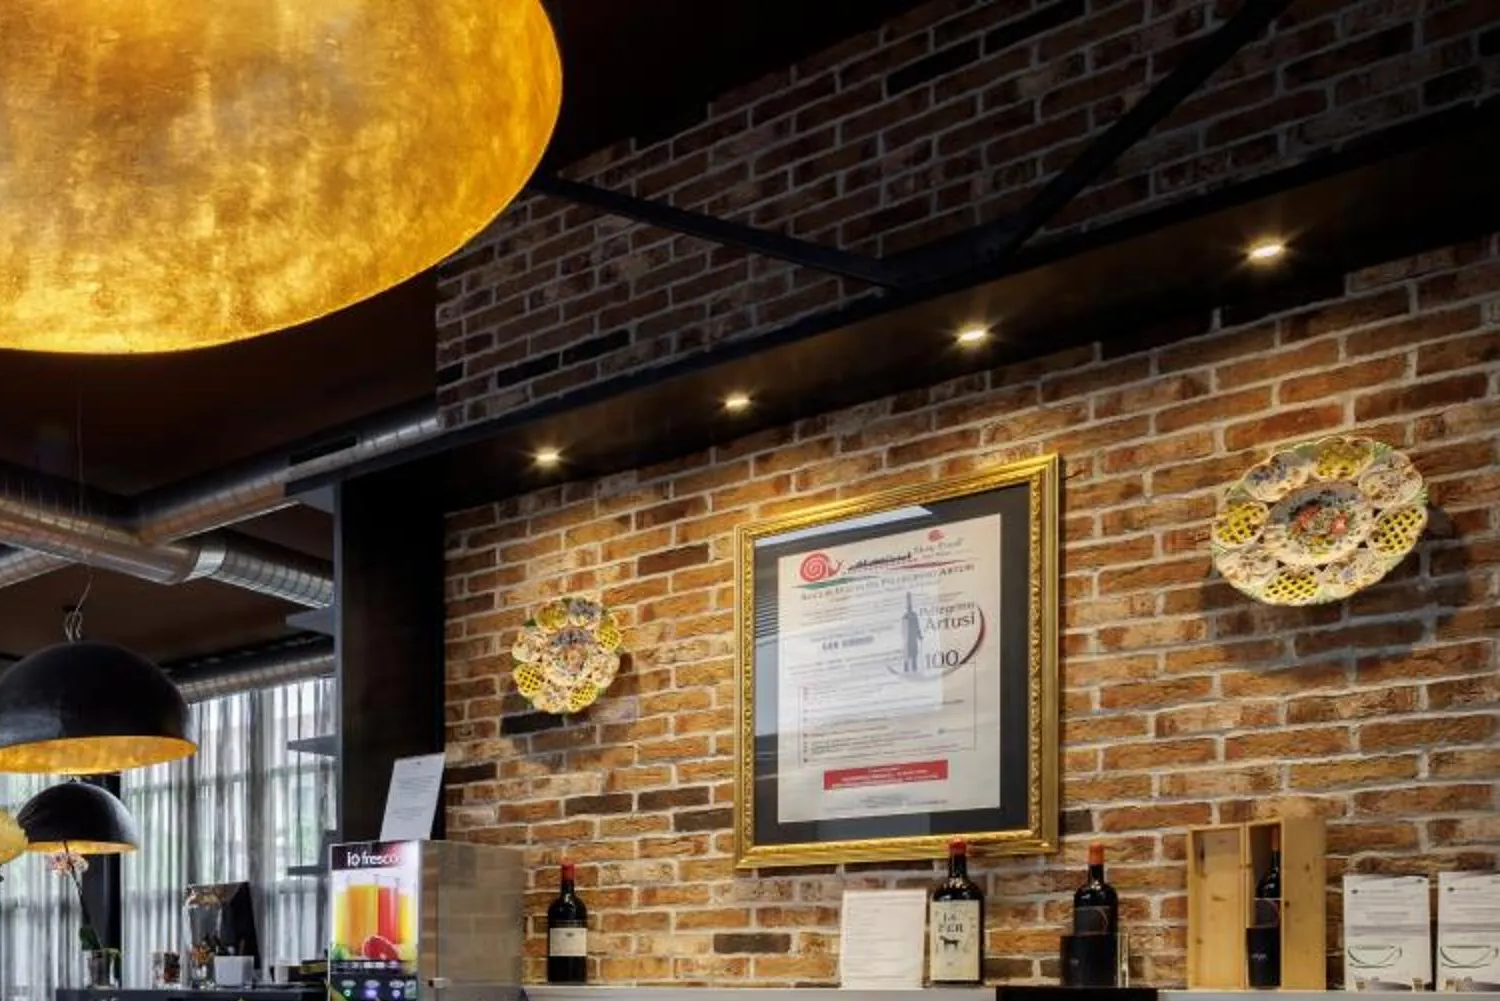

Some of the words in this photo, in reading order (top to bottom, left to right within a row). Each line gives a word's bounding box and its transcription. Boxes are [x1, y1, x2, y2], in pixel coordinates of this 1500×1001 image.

[924, 611, 975, 631] Artusi
[926, 649, 959, 670] 100
[361, 849, 399, 866] fresco
